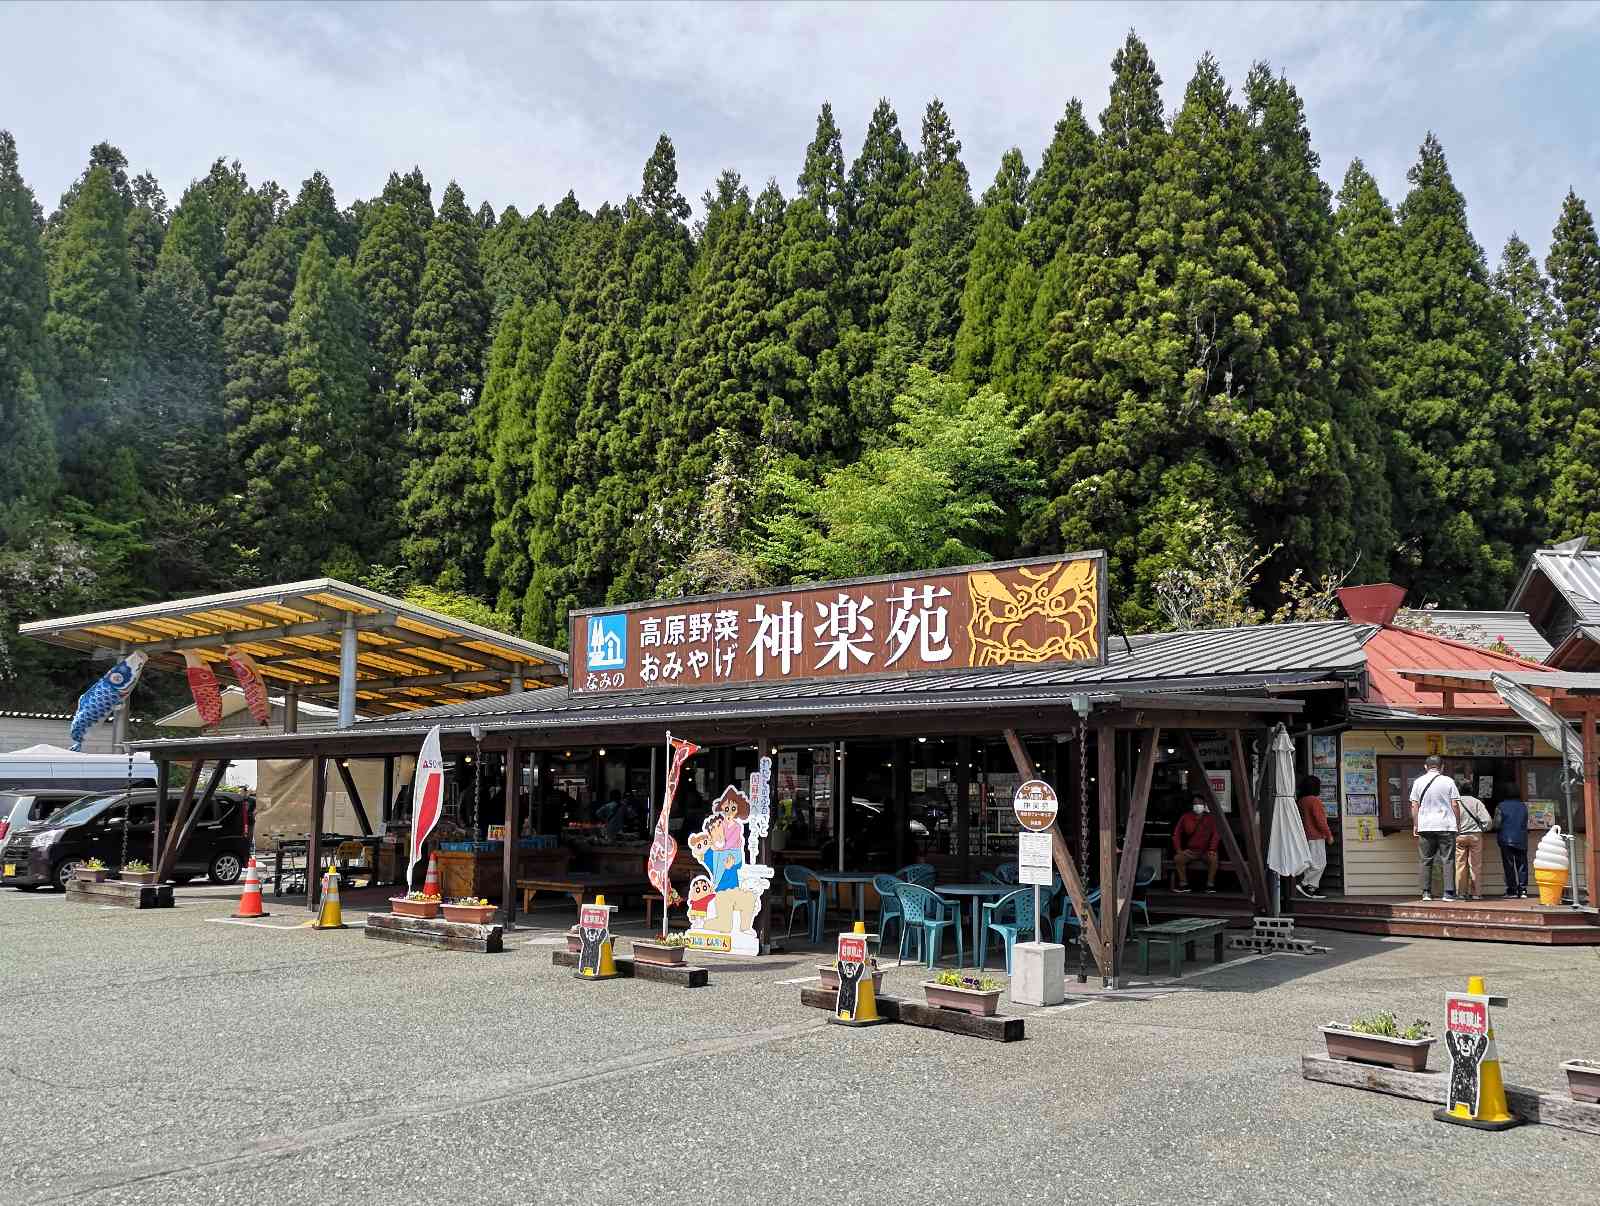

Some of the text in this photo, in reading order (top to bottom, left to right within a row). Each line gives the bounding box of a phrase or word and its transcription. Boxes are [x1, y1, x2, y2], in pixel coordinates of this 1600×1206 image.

[639, 609, 739, 648] 高原野菜
[746, 585, 952, 676] 神楽苑
[586, 672, 625, 691] なみの
[639, 643, 739, 682] おみやげ
